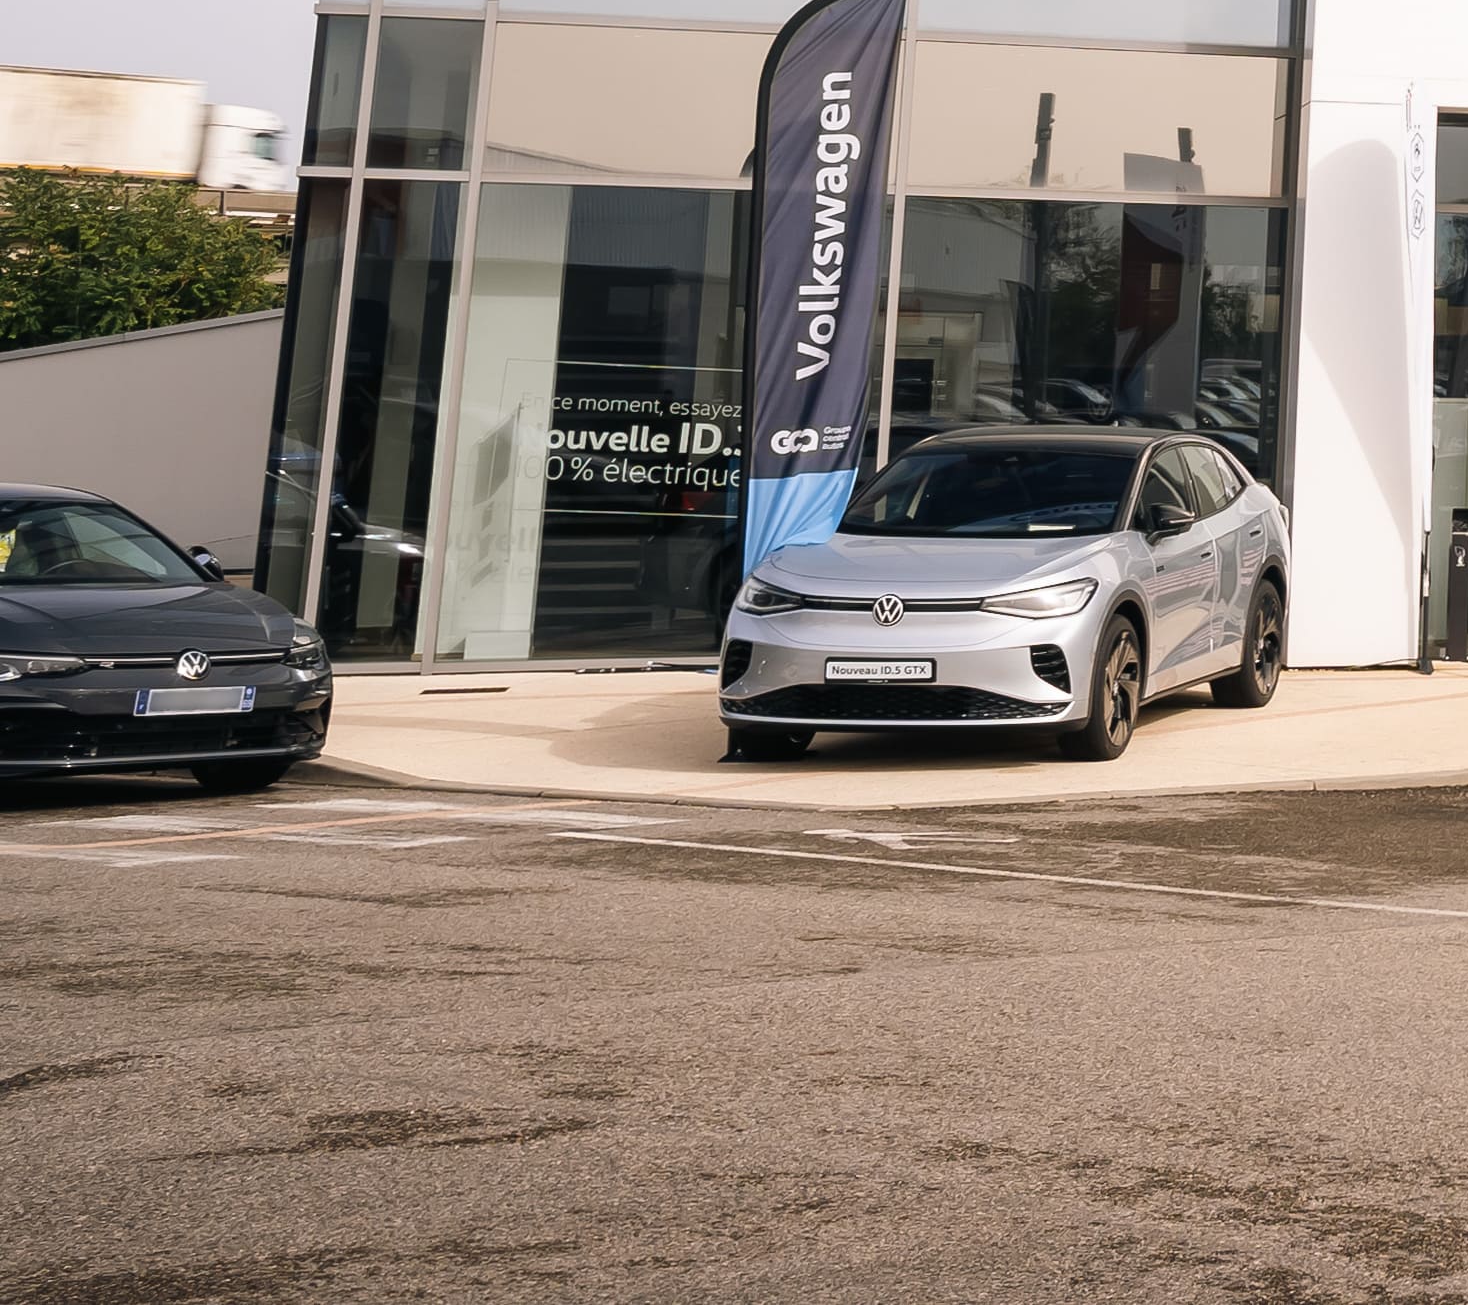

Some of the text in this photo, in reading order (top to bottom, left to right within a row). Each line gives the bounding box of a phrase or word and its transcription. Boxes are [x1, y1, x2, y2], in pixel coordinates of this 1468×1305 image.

[795, 69, 861, 381] Volkswagen
[551, 396, 573, 411] ce
[577, 396, 664, 417] moment,
[669, 400, 742, 421] essayez
[547, 424, 670, 453] ouvelle
[602, 458, 741, 492] électrique
[831, 665, 927, 675] Nouveau ID.5 GTX
